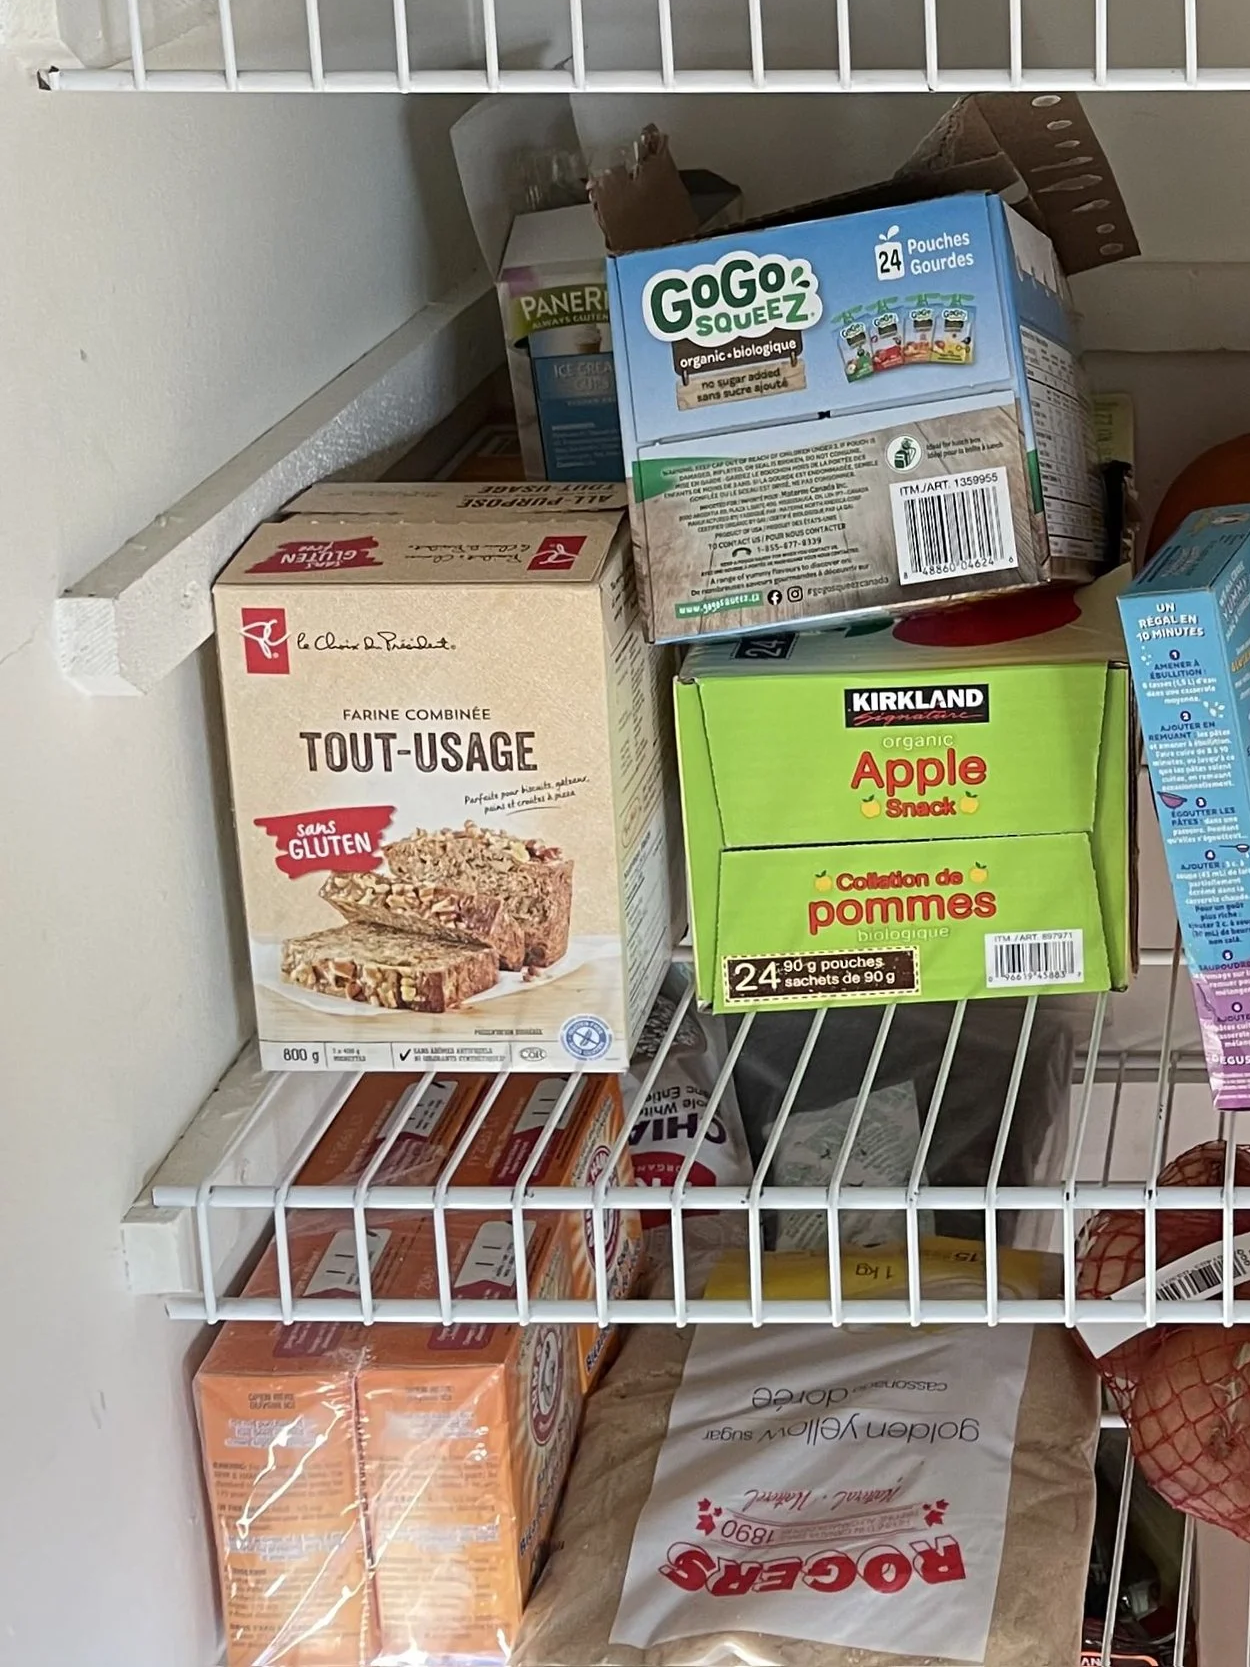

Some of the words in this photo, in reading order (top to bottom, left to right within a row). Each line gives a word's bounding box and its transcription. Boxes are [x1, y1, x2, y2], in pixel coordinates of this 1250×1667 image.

[878, 249, 901, 274] 24
[908, 231, 970, 254] Pouches
[910, 251, 974, 276] Gourdes
[651, 259, 786, 333] GoGo
[532, 317, 571, 330] ALWAYS
[696, 293, 808, 337] SQUEEZ
[702, 379, 715, 389] no
[717, 374, 746, 388] sugar
[749, 368, 780, 382] added
[697, 389, 721, 402] sans
[724, 385, 753, 397] sucre
[756, 379, 788, 393] ajouté
[281, 550, 358, 564] GLUTEN
[1156, 603, 1175, 613] UN
[1139, 615, 1178, 630] RÉGAL
[1180, 614, 1198, 625] EN
[1136, 632, 1150, 643] 10
[1151, 627, 1205, 640] MINUTES
[745, 636, 784, 657] 24
[853, 688, 983, 712] KIRKLAND
[343, 709, 399, 721] FARINE
[405, 706, 490, 720] COMBINÉE
[853, 711, 983, 725] Signature
[300, 731, 538, 772] TOUT-USAGE
[882, 733, 955, 751] organic
[851, 748, 987, 796] Apple
[886, 797, 957, 818] Snack
[297, 820, 336, 837] sans
[288, 832, 371, 860] GLUTEN
[836, 872, 929, 891] Collation
[935, 869, 963, 884] de
[808, 891, 997, 936] pommes
[857, 925, 949, 942] biologique
[784, 958, 802, 971] 90
[807, 960, 817, 974] g
[821, 955, 883, 972] pouches
[734, 962, 780, 991] 24
[785, 971, 838, 987] sachets
[843, 971, 860, 984] de
[864, 971, 883, 982] 90
[886, 973, 895, 984] g
[284, 1049, 307, 1061] 800
[313, 1051, 319, 1064] g
[752, 1387, 849, 1412] dorée
[702, 1430, 753, 1442] sugar
[757, 1413, 860, 1446] yellow
[866, 1417, 980, 1444] golden
[721, 1519, 775, 1546] 1890
[658, 1534, 966, 1597] ROGERS
